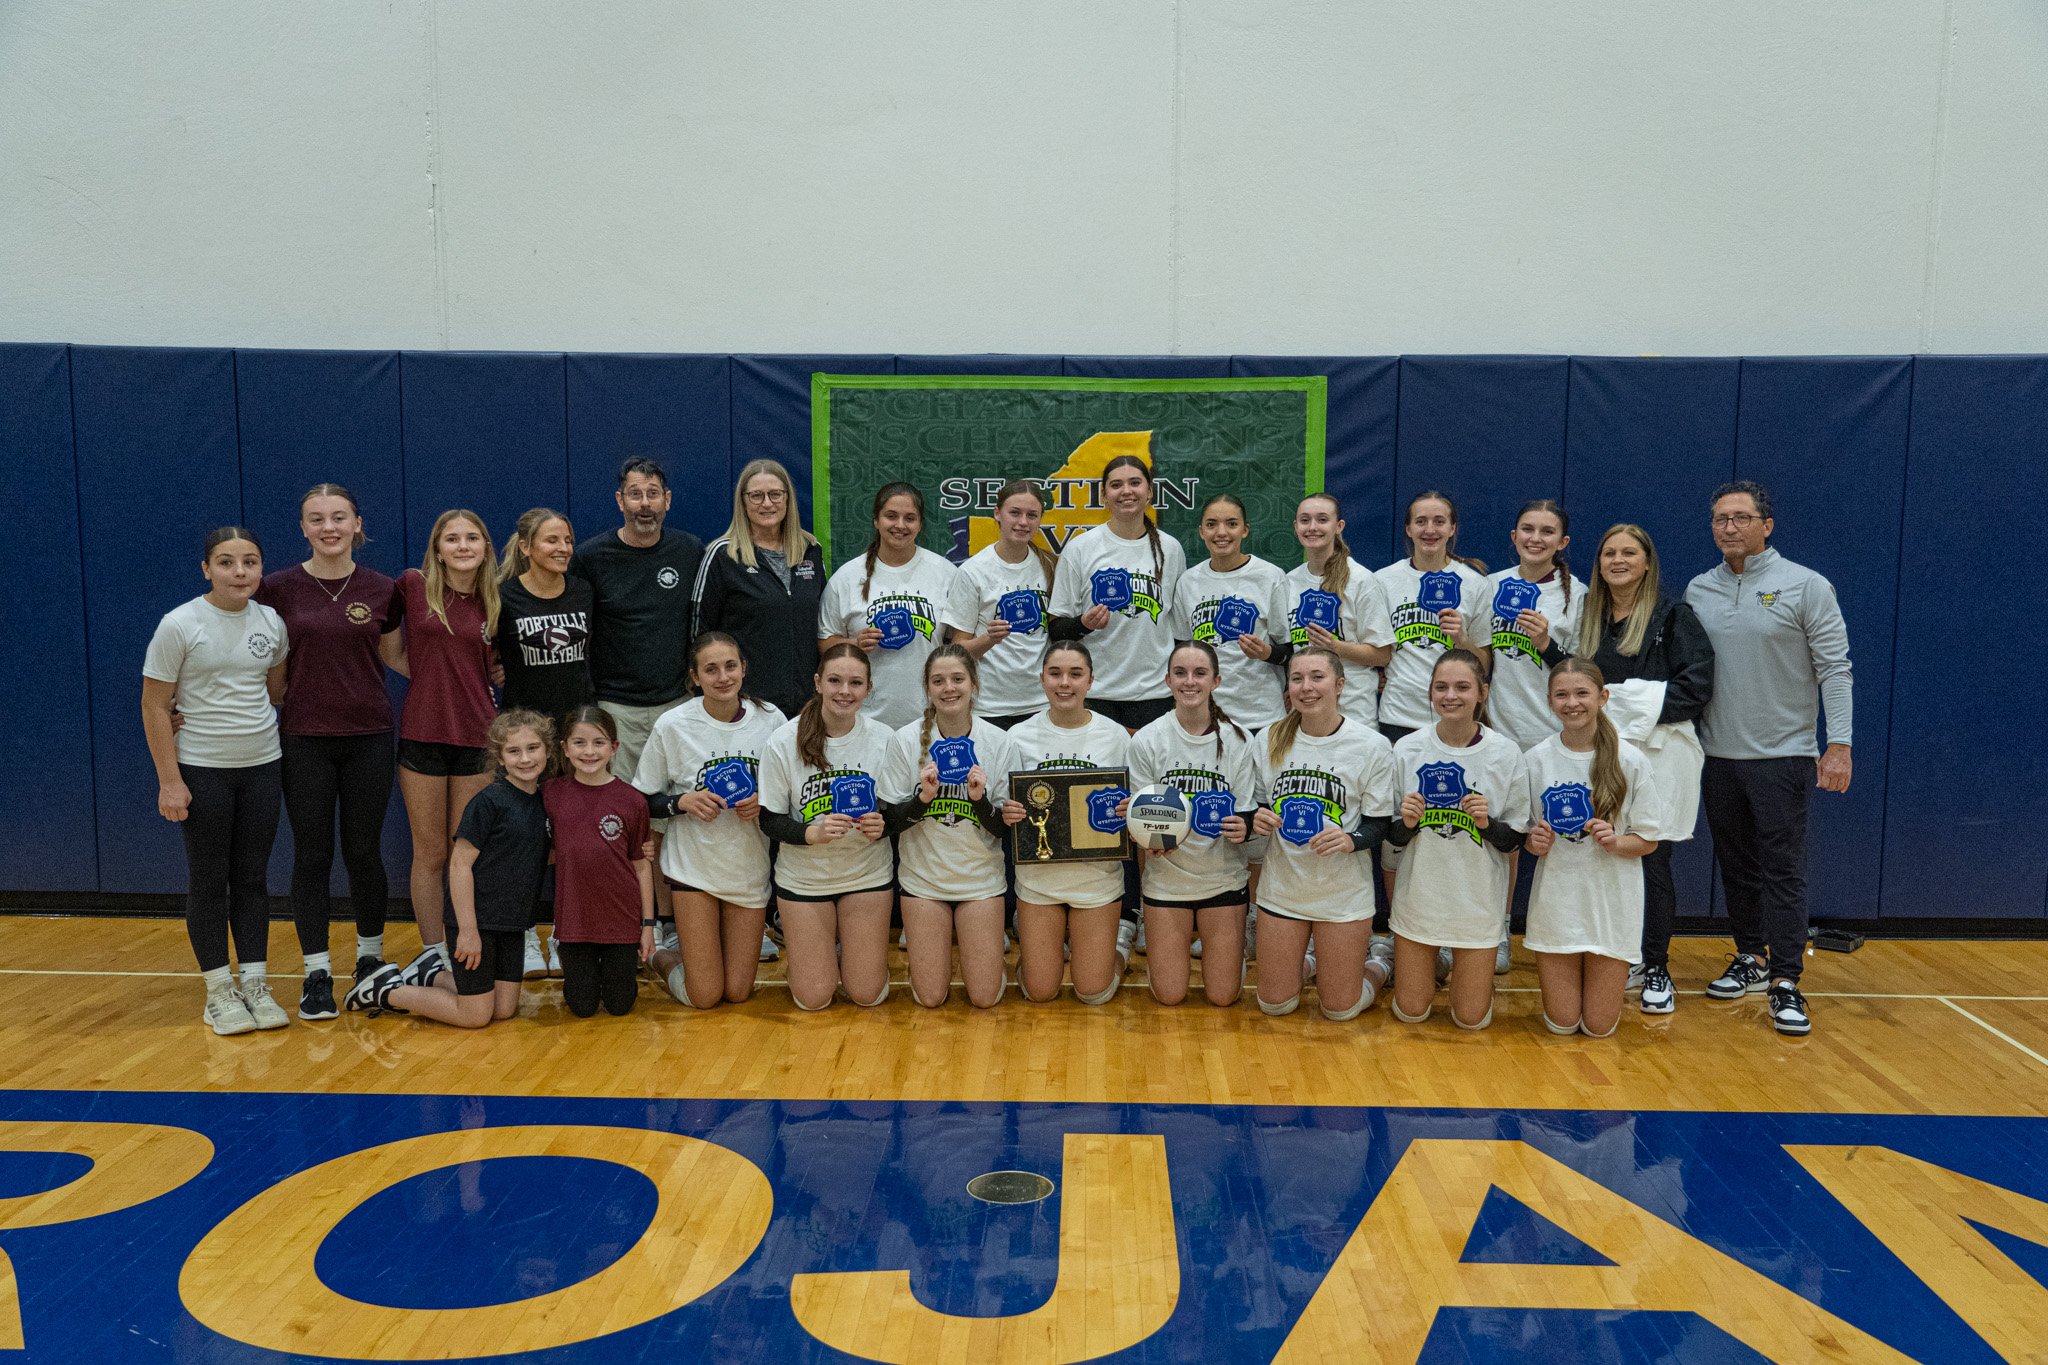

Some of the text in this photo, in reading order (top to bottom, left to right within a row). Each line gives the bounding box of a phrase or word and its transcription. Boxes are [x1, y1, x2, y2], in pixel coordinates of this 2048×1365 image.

[940, 477, 1200, 510] SETIN
[1039, 525, 1098, 556] V
[1099, 575, 1123, 584] SECTION
[1506, 585, 1531, 595] SECTION
[1006, 598, 1031, 608] SECTION
[1134, 595, 1155, 611] PION
[1308, 597, 1333, 606] SECTION
[1227, 605, 1251, 616] SECTION
[1234, 609, 1242, 617] VI
[881, 614, 905, 624] SECTION
[515, 611, 589, 641] PORTVILLE
[1398, 625, 1448, 643] CHAMPION
[939, 744, 965, 755] SECTION
[948, 749, 957, 757] VI
[1045, 752, 1091, 760] 2024
[1174, 762, 1220, 771] 2024
[1290, 761, 1335, 772] 2024
[713, 767, 738, 783] SECTION
[722, 773, 732, 782] VI
[1427, 770, 1455, 778] SECTION
[840, 783, 866, 792] SECTION
[1272, 775, 1328, 800] SECTION
[1330, 780, 1346, 810] VI
[1095, 795, 1122, 805] SECTION
[1200, 798, 1227, 806] SECTION
[1551, 792, 1579, 802] SECTION
[1209, 802, 1218, 810] VI
[1289, 804, 1315, 812] SECTION
[1140, 806, 1177, 819] SPALDING
